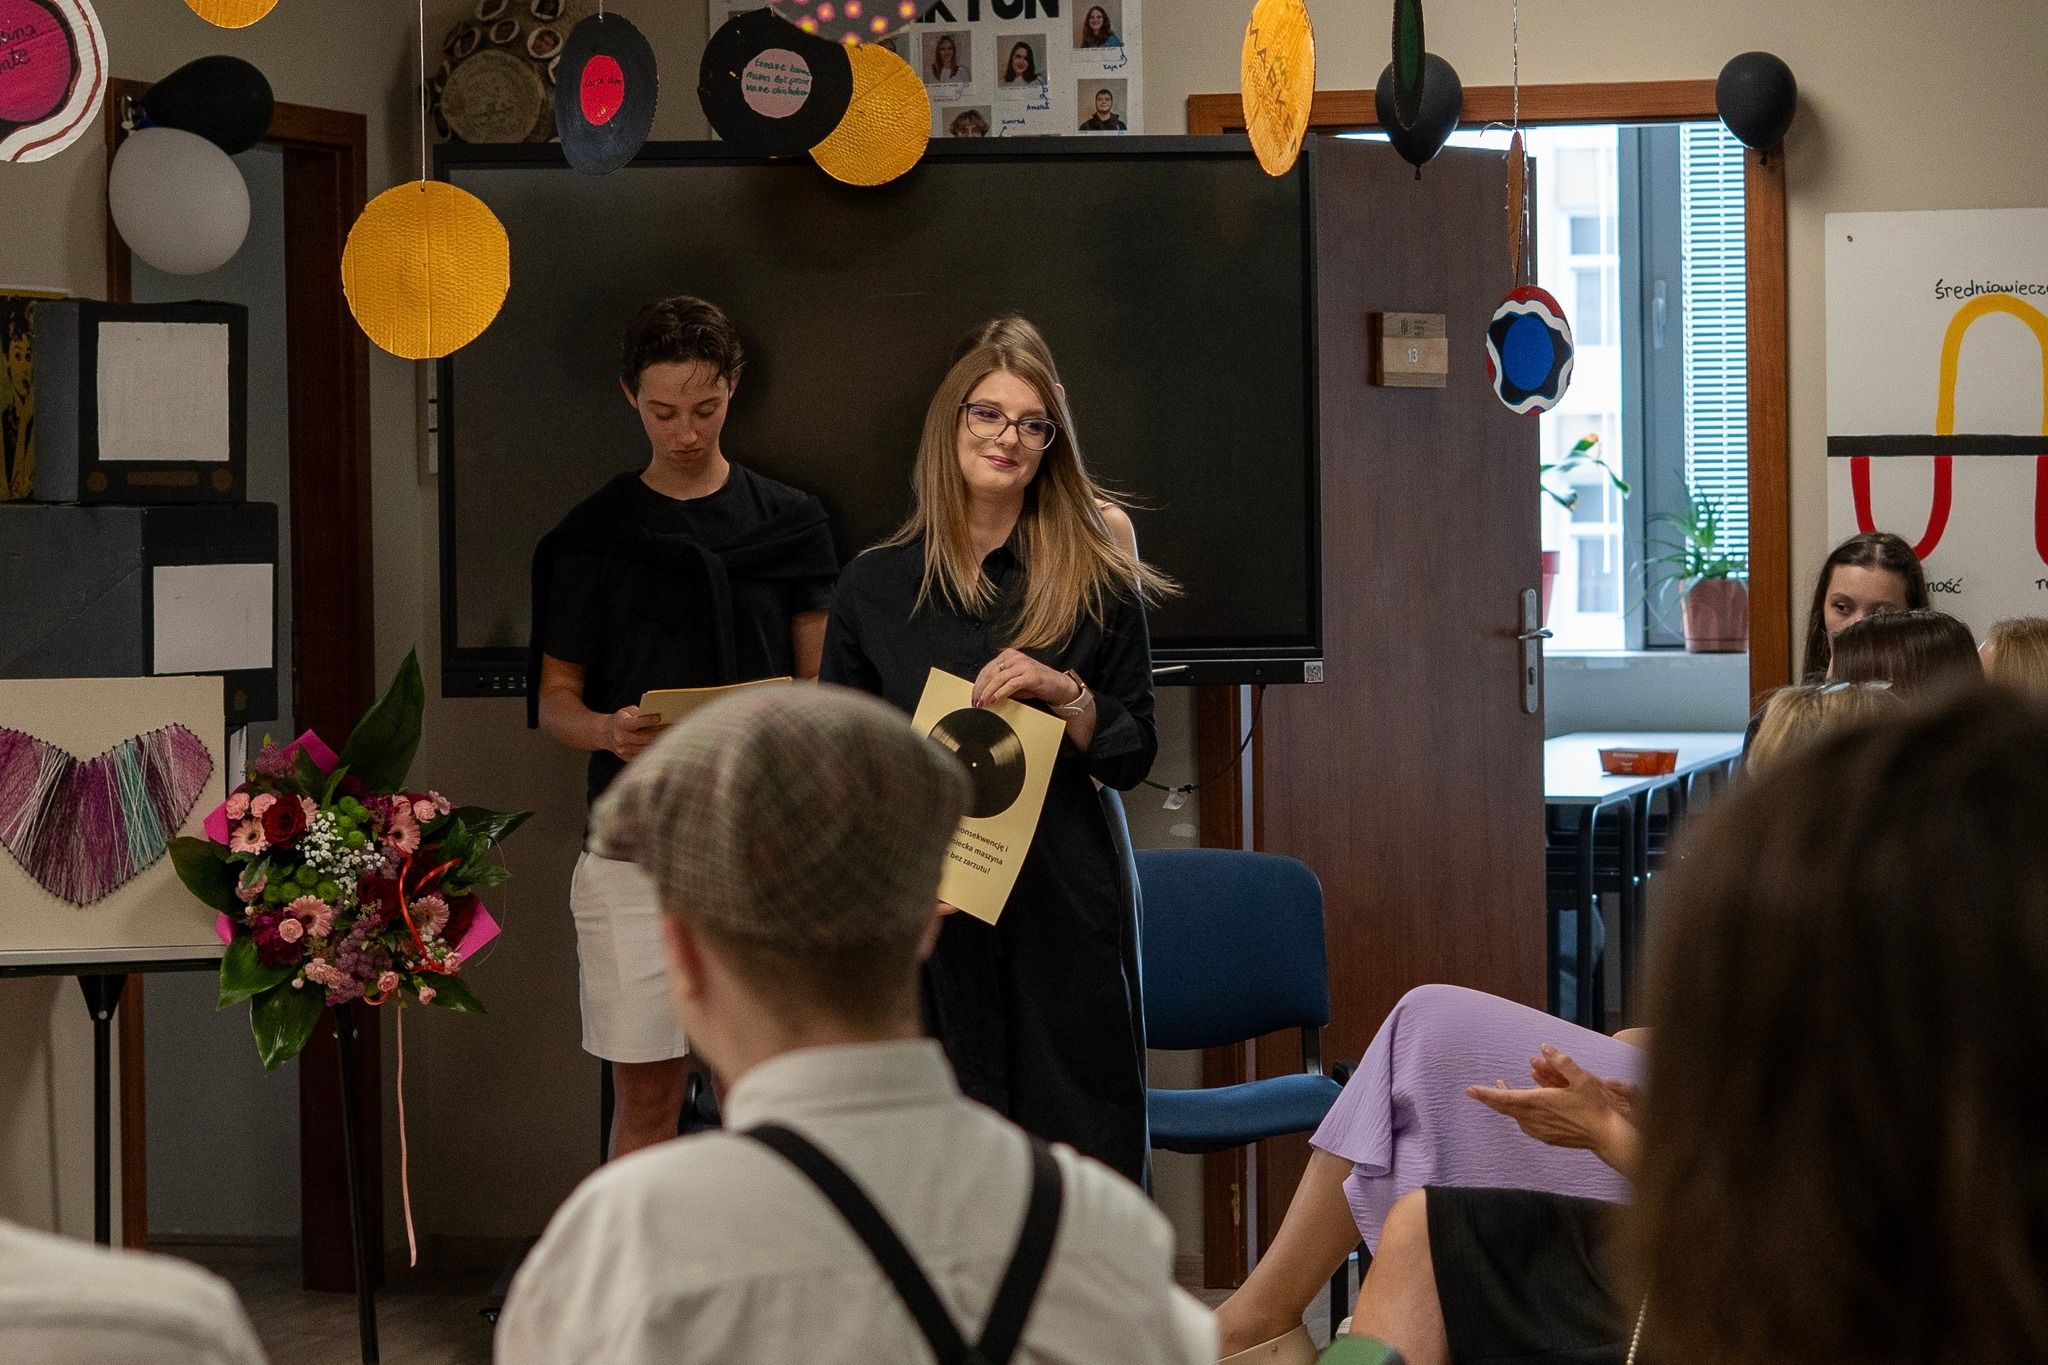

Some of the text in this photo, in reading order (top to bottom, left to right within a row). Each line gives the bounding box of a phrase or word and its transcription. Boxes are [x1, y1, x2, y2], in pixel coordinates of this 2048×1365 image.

[1935, 278, 2048, 300] średniowiecz
[1407, 348, 1418, 363] 13
[957, 825, 1005, 852] onsekwencję
[950, 851, 963, 863] bez
[963, 858, 991, 875] zarzutu!
[974, 848, 1003, 866] maszyna
